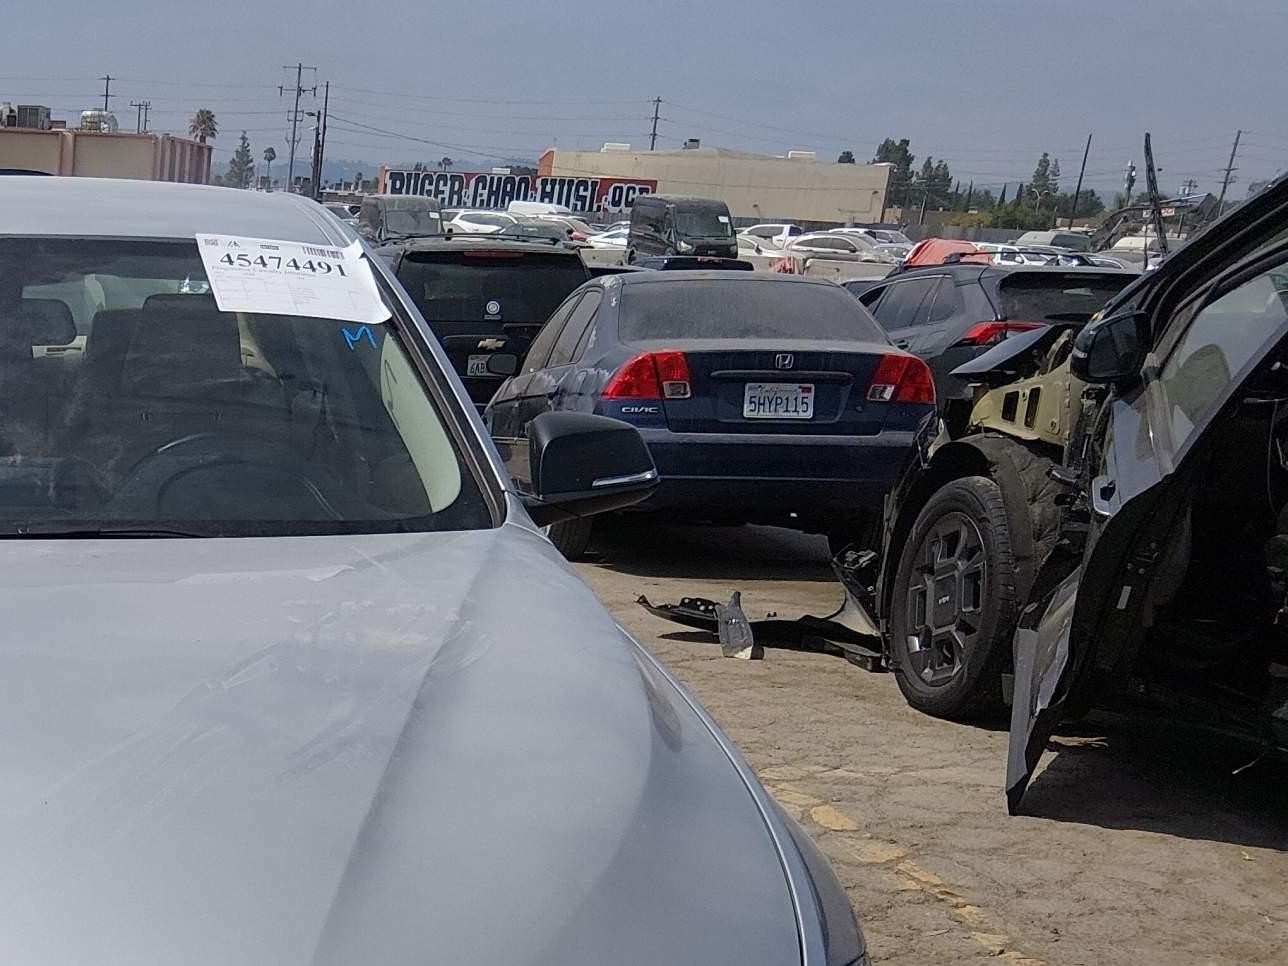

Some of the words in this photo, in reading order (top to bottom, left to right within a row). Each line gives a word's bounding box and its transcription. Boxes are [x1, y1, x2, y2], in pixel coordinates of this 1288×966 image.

[219, 252, 350, 277] 45474491
[342, 325, 377, 351] M
[749, 396, 809, 414] 5HYP115
